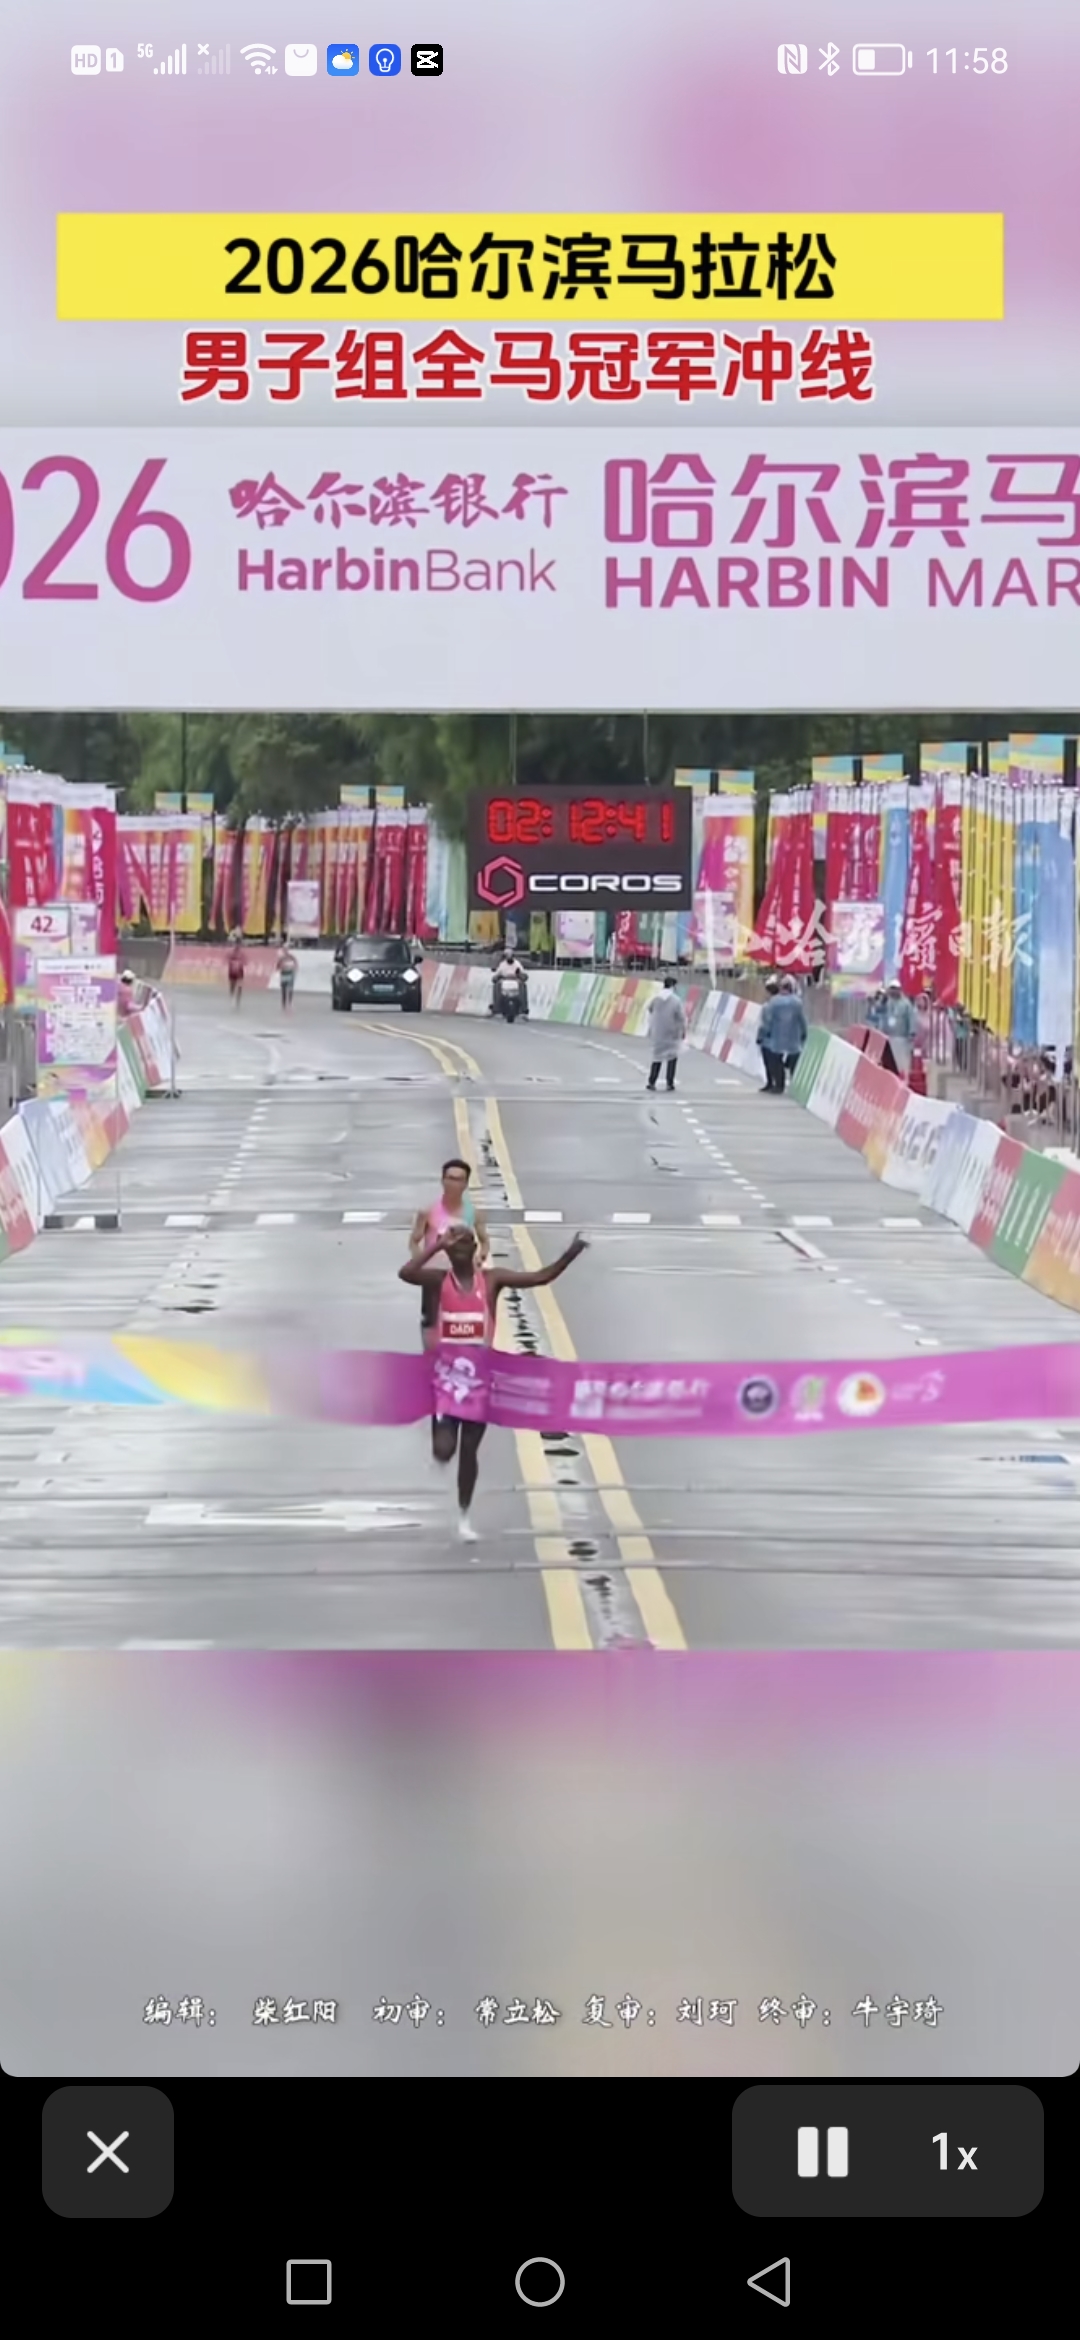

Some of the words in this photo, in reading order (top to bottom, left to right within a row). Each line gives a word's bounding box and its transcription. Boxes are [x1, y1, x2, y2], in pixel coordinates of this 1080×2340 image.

[230, 472, 568, 530] 哈尔滨银行
[605, 452, 1080, 549] 哈尔滨马
[0, 455, 193, 604] 26
[238, 548, 557, 592] HarbinBank
[606, 556, 890, 609] HARBIN
[928, 557, 1080, 608] MAR
[528, 873, 683, 894] COROS
[30, 916, 54, 933] 42
